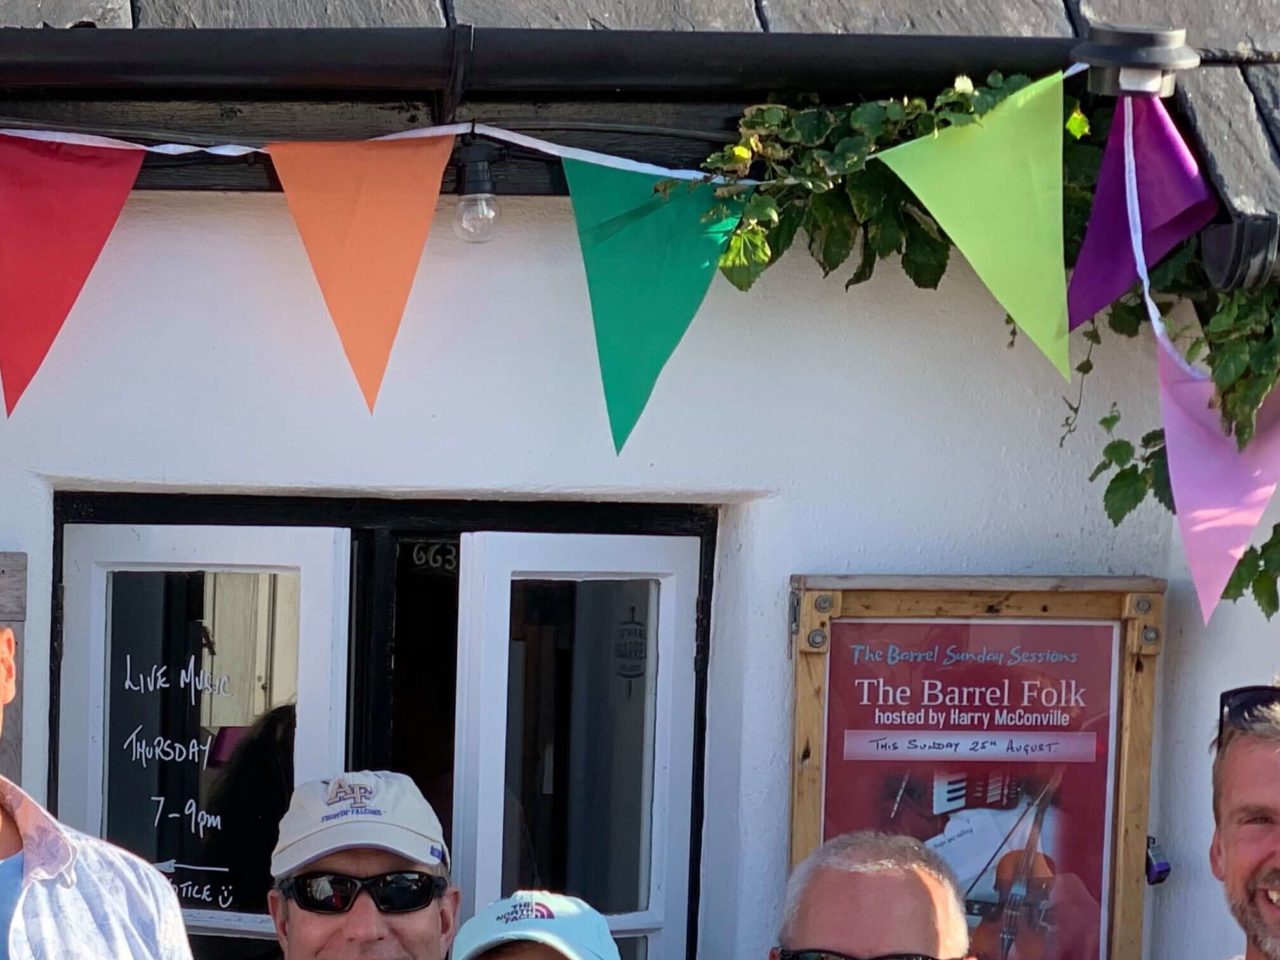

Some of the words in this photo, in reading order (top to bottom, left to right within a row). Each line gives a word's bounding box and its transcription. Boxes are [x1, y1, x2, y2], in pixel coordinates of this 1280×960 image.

[849, 644, 883, 666] The
[886, 645, 938, 666] Barrel
[942, 645, 1005, 666] Sunday
[1006, 646, 1078, 666] Sessions
[854, 678, 911, 706] The
[921, 679, 1010, 707] Barrel
[1020, 680, 1087, 708] Folk
[874, 708, 925, 725] hosted
[928, 708, 946, 729] by
[950, 710, 990, 729] Harry
[994, 710, 1071, 727] McConville
[123, 724, 213, 771] THURSDAY
